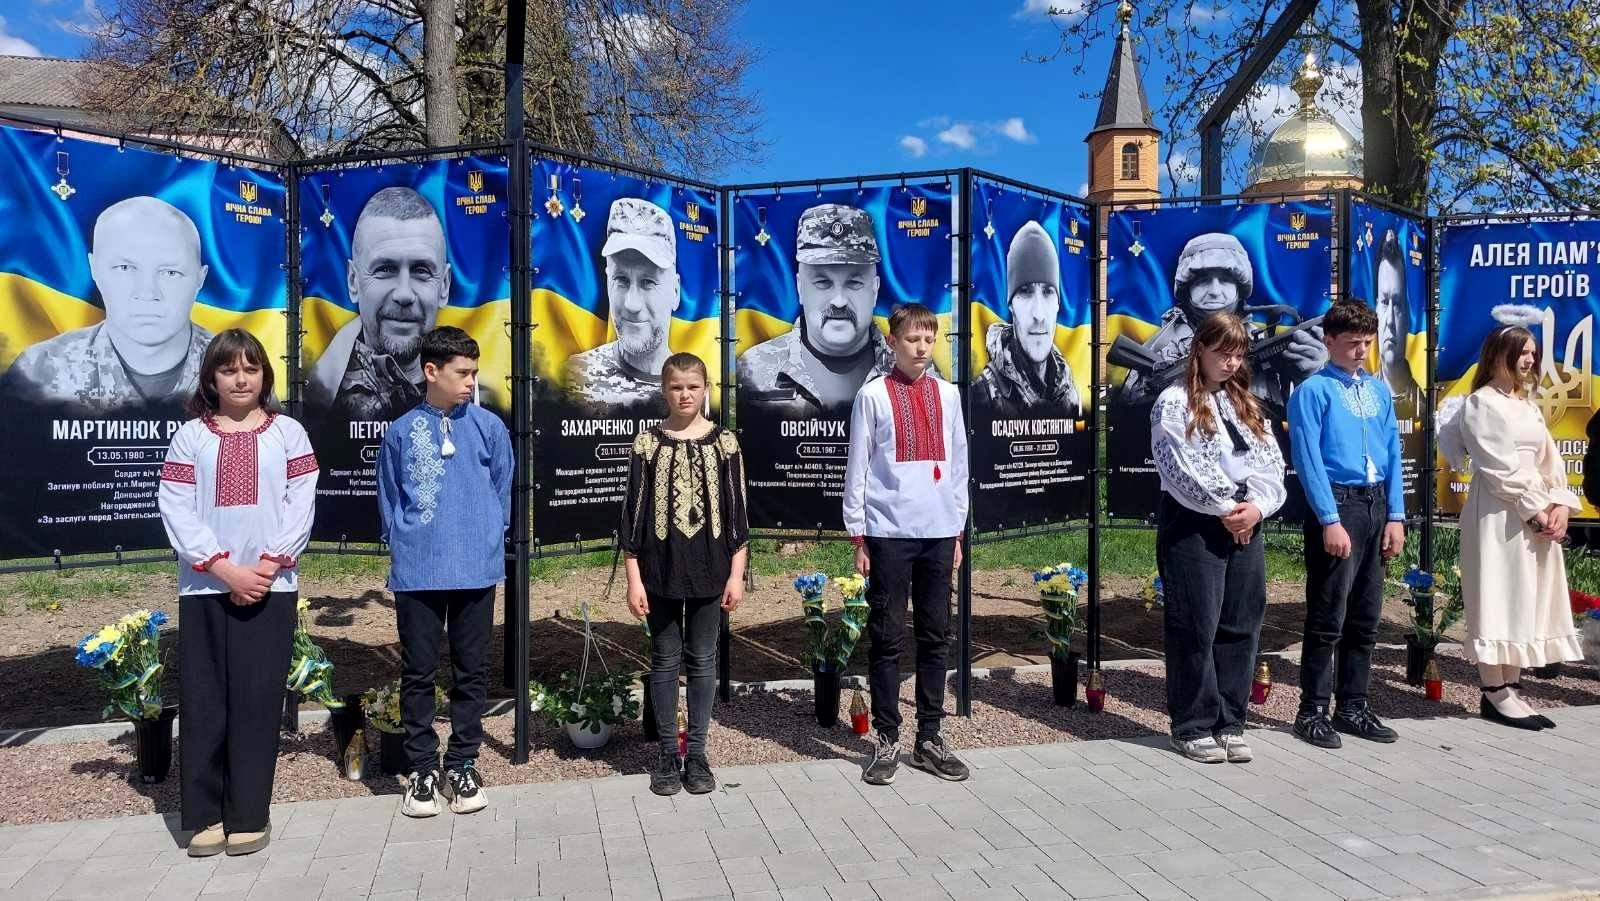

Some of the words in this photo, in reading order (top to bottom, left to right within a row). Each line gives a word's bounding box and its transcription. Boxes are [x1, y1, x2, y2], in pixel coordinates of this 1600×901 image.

[456, 196, 474, 206] ВІЧНА
[475, 194, 496, 204] СЛАВА
[225, 202, 247, 213] ВІЧНА
[248, 205, 272, 217] СЛАВА
[898, 219, 917, 229] ВІЧНА
[917, 218, 939, 228] СЛАВА
[1277, 233, 1296, 242] ВІЧНА
[1297, 232, 1319, 241] СЛАВА
[1470, 243, 1531, 267] АЛЕЯ
[1538, 241, 1600, 265] ПАМ’
[1510, 270, 1590, 298] ГЕРОЇВ
[52, 419, 161, 440] МАРТИНЮК
[561, 419, 634, 437] ЗАХАРЧЕНКО
[780, 418, 846, 437] ОВСІЙЧУК
[991, 420, 1030, 437] ОСАДЧУК
[1031, 418, 1074, 435] КОСТЯНТИН
[97, 451, 145, 460] 13.05.1980
[114, 469, 141, 478] Солдат
[47, 482, 81, 491] Загинув
[83, 480, 114, 490] поблизу
[113, 491, 152, 500] Донецької
[100, 501, 156, 511] Нагороджений
[55, 514, 87, 524] заслуги
[88, 513, 112, 522] перед
